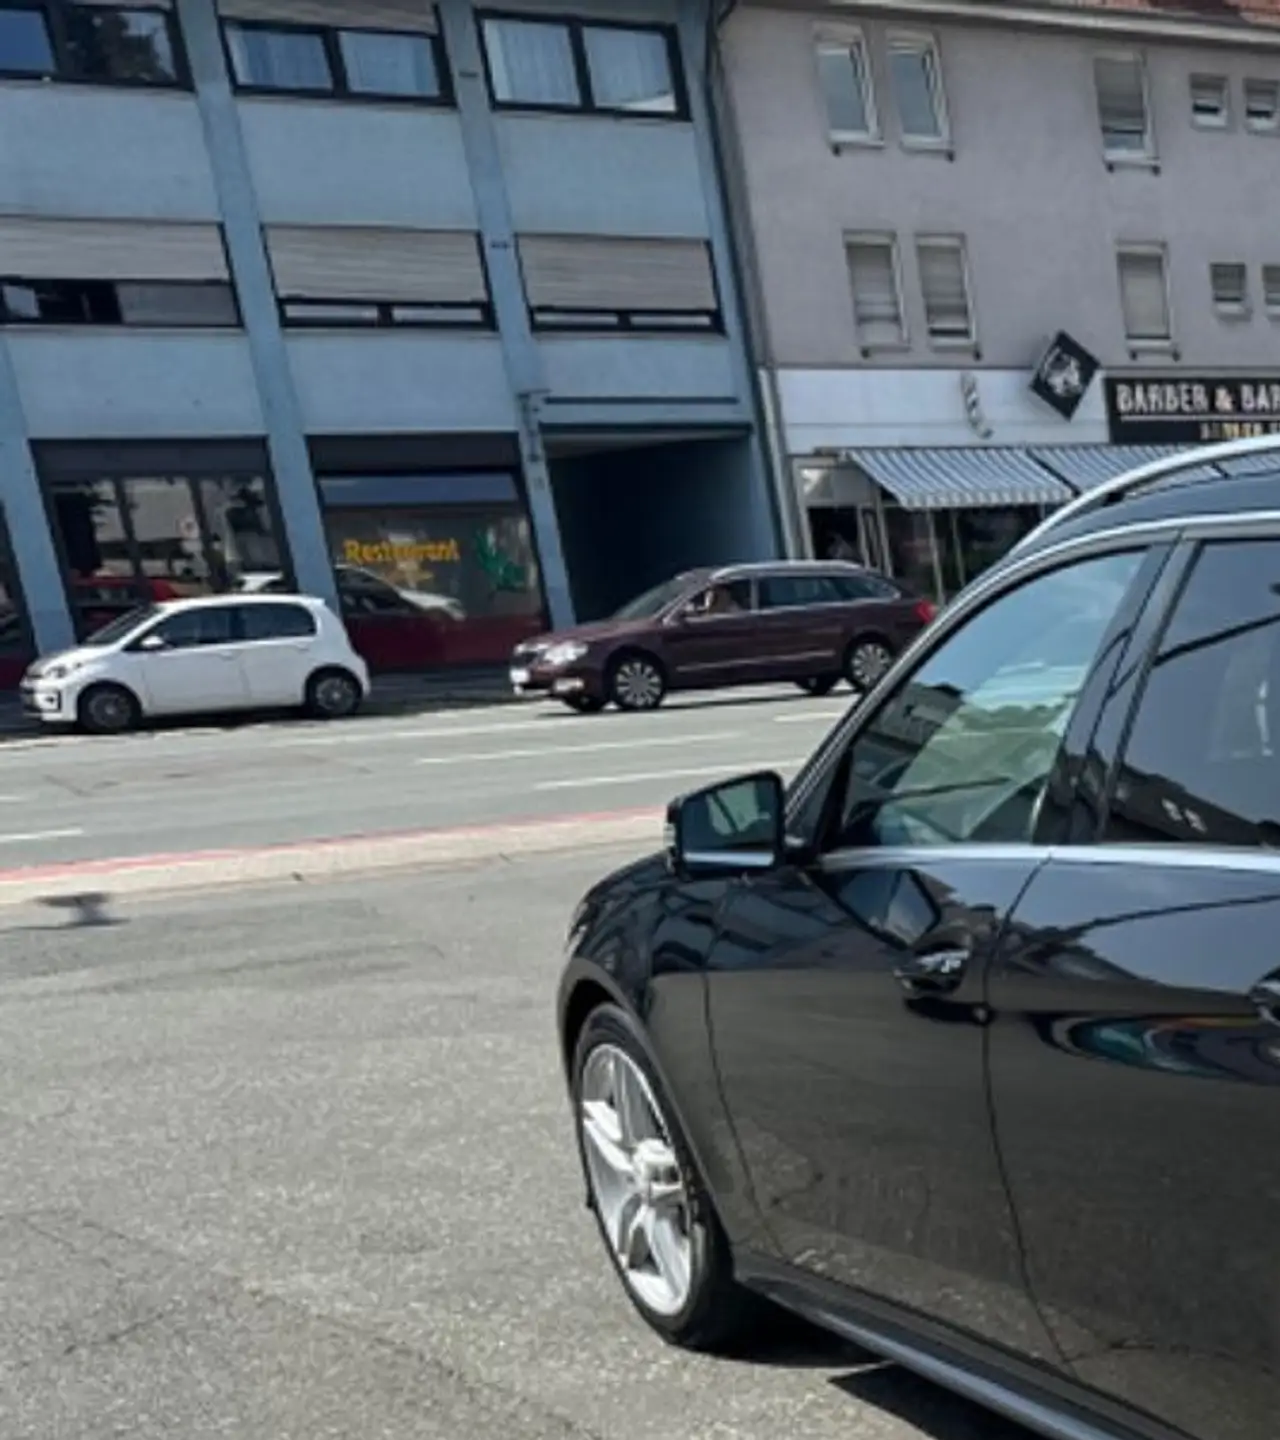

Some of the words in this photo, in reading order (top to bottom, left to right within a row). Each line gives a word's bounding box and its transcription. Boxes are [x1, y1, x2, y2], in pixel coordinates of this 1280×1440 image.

[1116, 382, 1208, 413] BARBER
[1215, 386, 1233, 413] &
[343, 537, 461, 564] Restaurant
